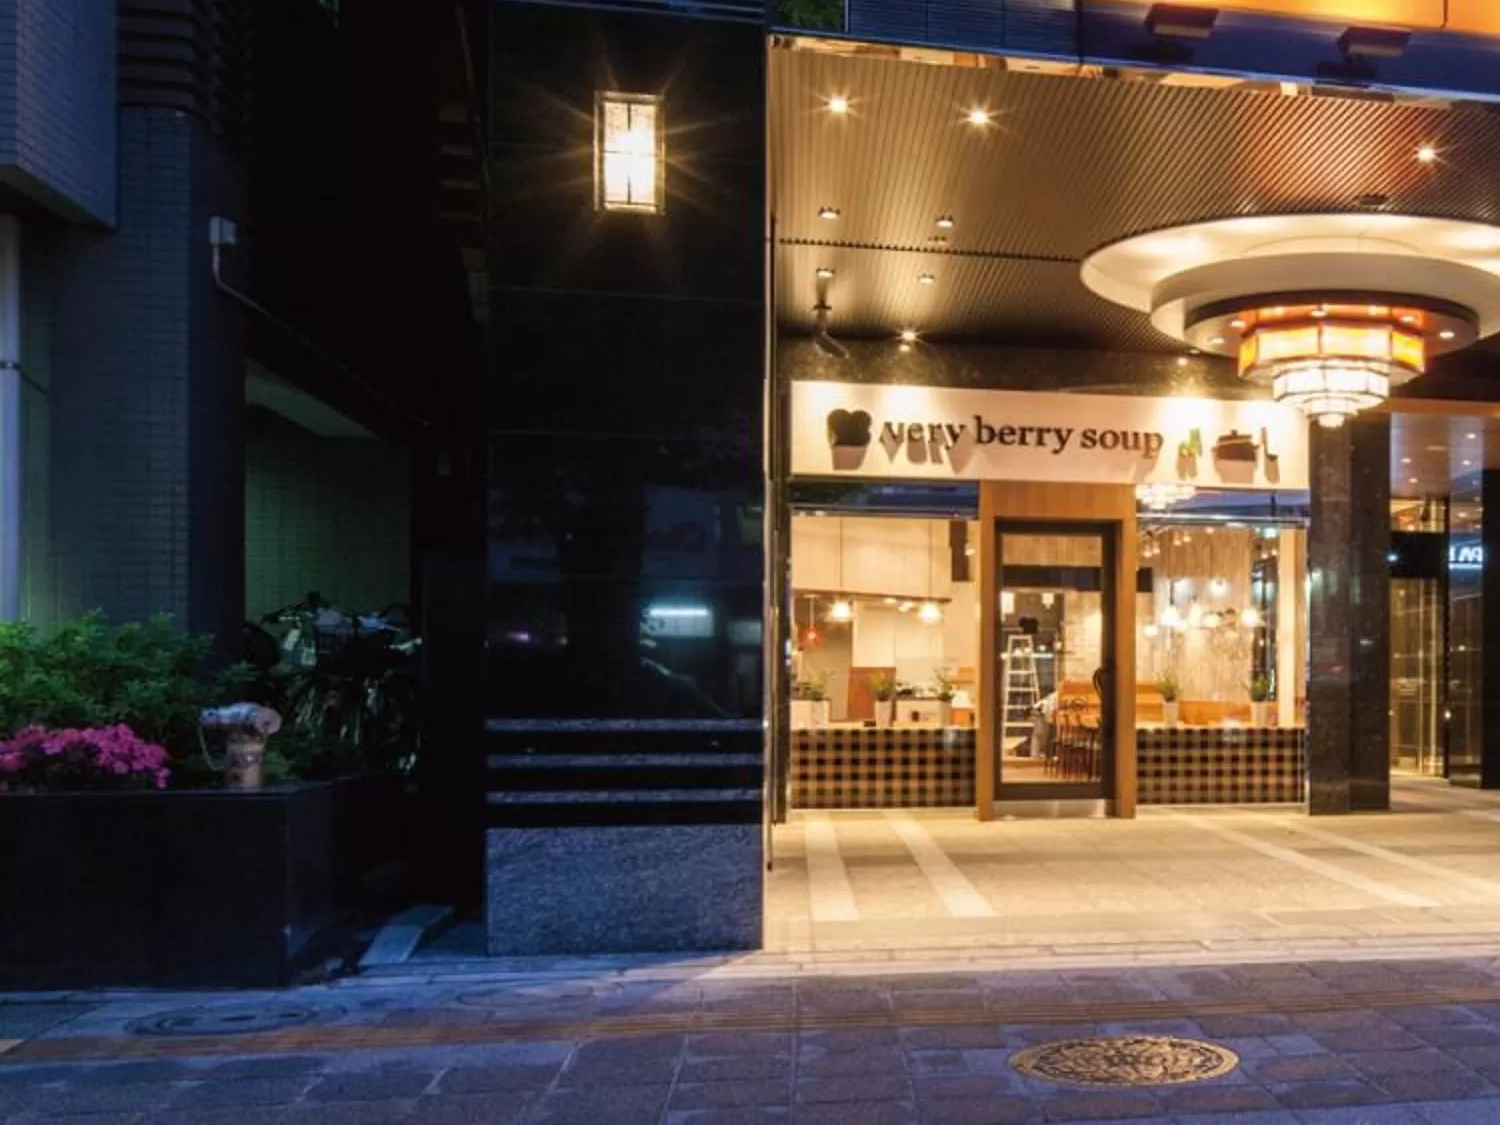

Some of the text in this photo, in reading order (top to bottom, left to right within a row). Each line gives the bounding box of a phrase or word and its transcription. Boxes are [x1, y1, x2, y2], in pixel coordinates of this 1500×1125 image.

[879, 415, 1164, 460] very berry soup
